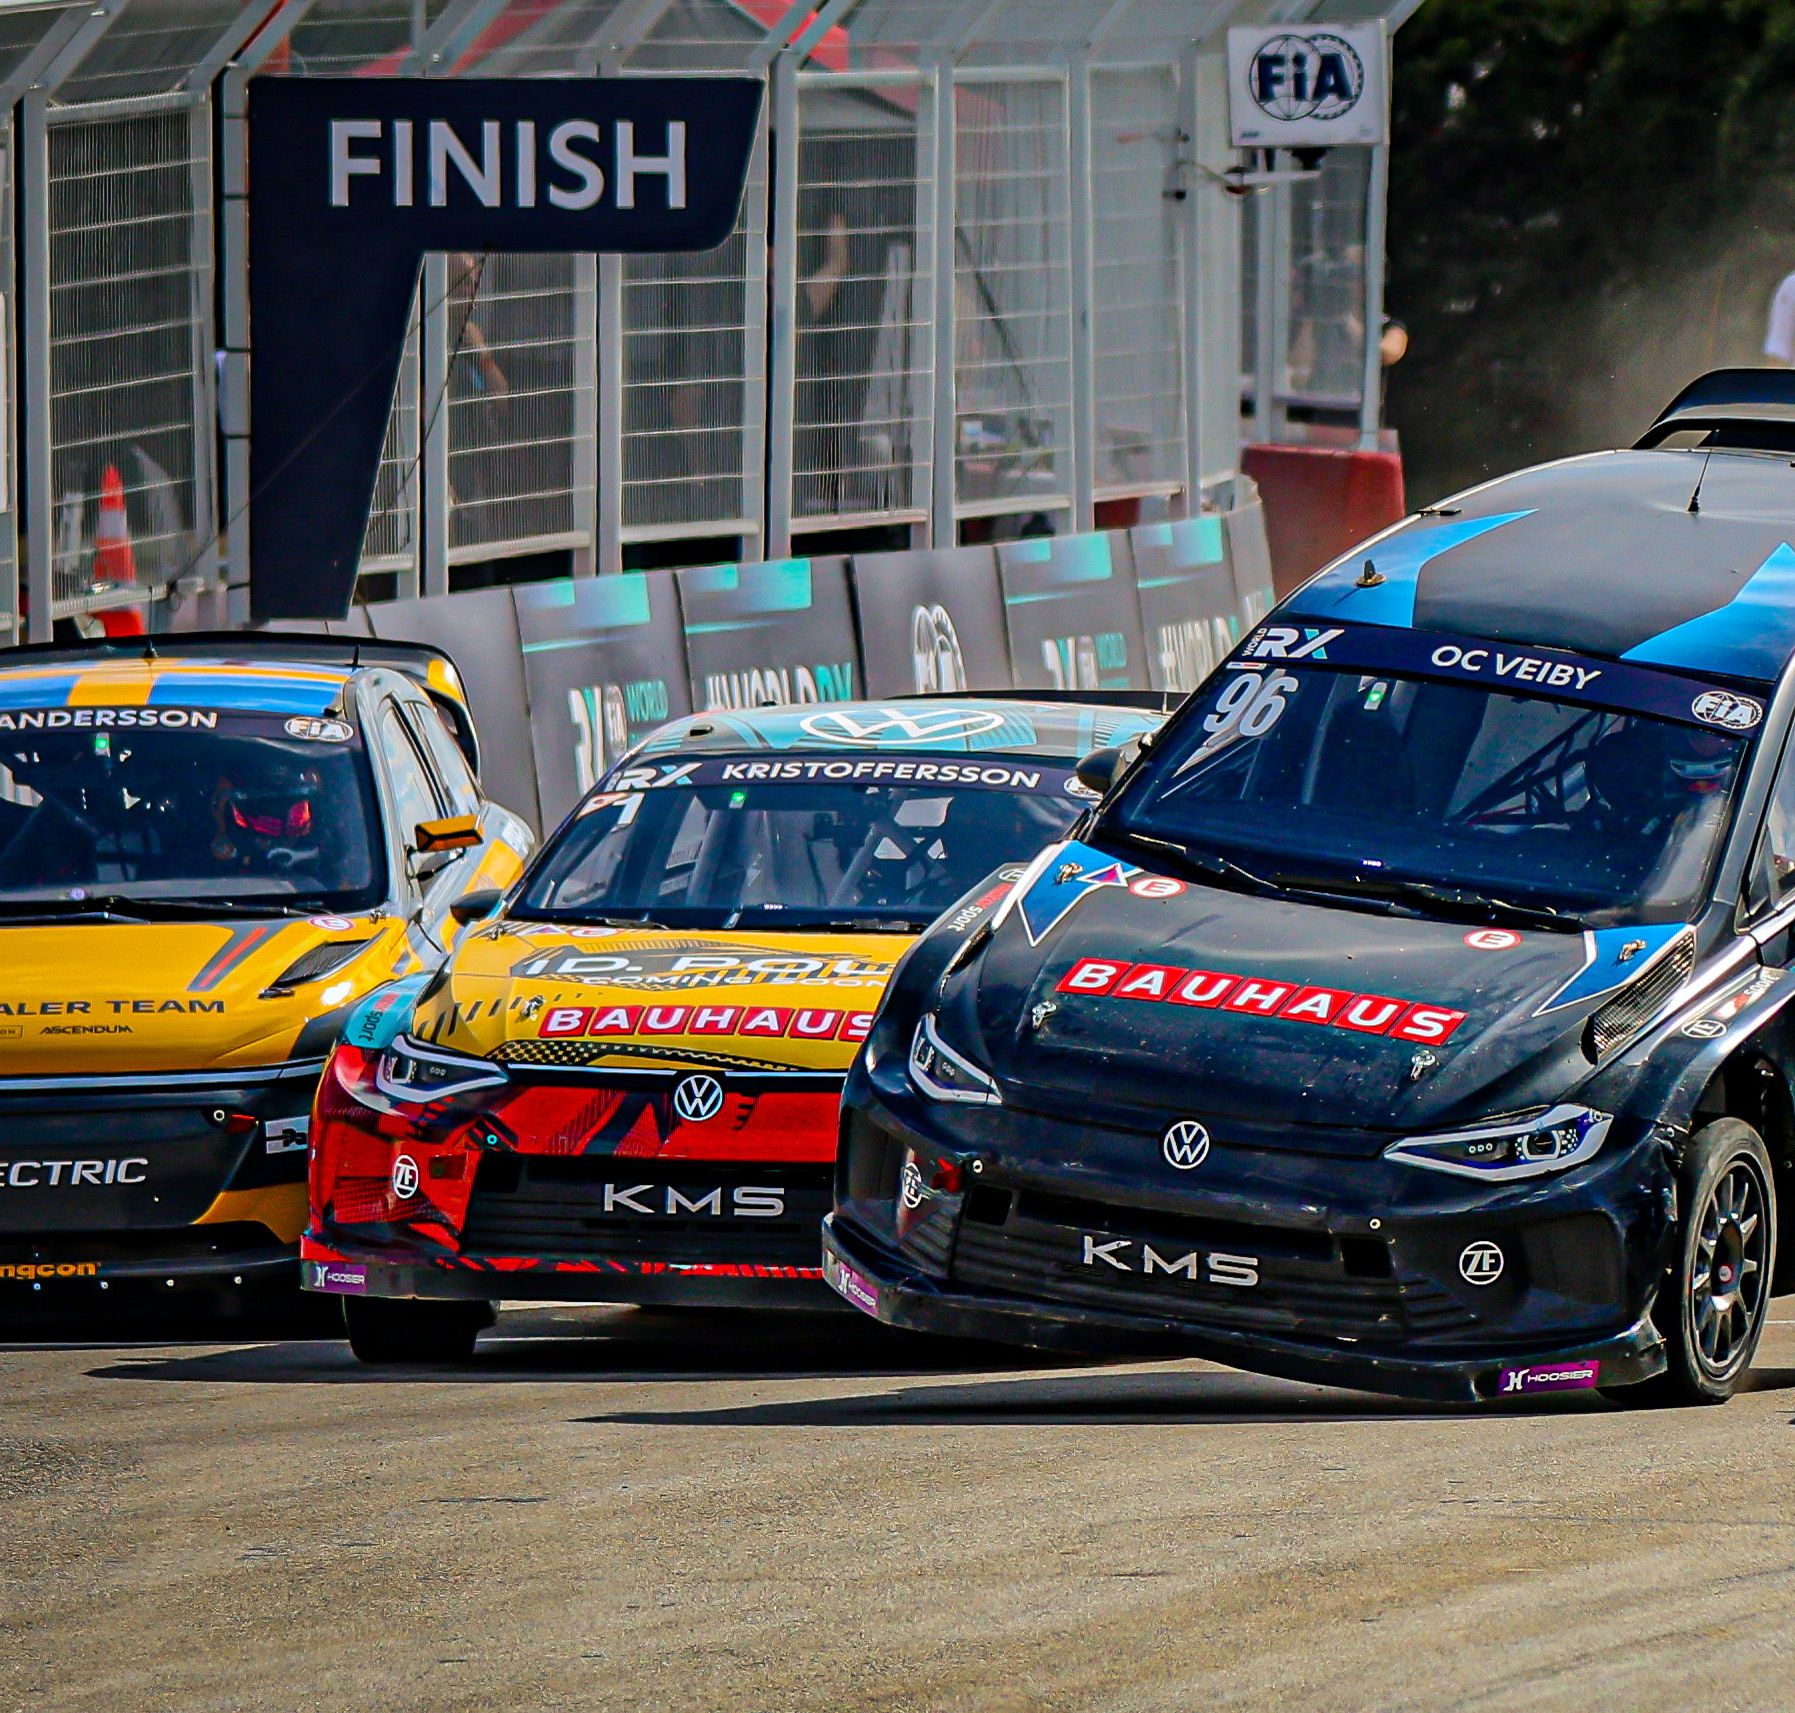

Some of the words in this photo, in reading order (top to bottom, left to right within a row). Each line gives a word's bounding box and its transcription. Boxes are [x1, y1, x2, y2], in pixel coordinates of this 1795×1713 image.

[329, 119, 687, 209] FINISH
[1241, 627, 1268, 657] WORLD
[1254, 628, 1345, 660] RX
[1431, 645, 1489, 671] OC
[1495, 653, 1602, 690] VEIBY
[0, 710, 218, 729] ANDERSSON
[1203, 673, 1299, 737] 96
[722, 761, 1040, 789] KRISTOFFERSSON
[582, 975, 751, 985] COMING
[769, 976, 887, 987] SOON
[106, 1000, 225, 1014] TEAM
[1068, 963, 1456, 1039] BAUHAUS
[40, 1025, 134, 1036] ASCENDUM
[547, 1007, 873, 1035] BAUHAUS
[604, 1183, 785, 1217] KMS
[1083, 1234, 1259, 1287] KMS
[1527, 1369, 1594, 1383] HOOSIER
